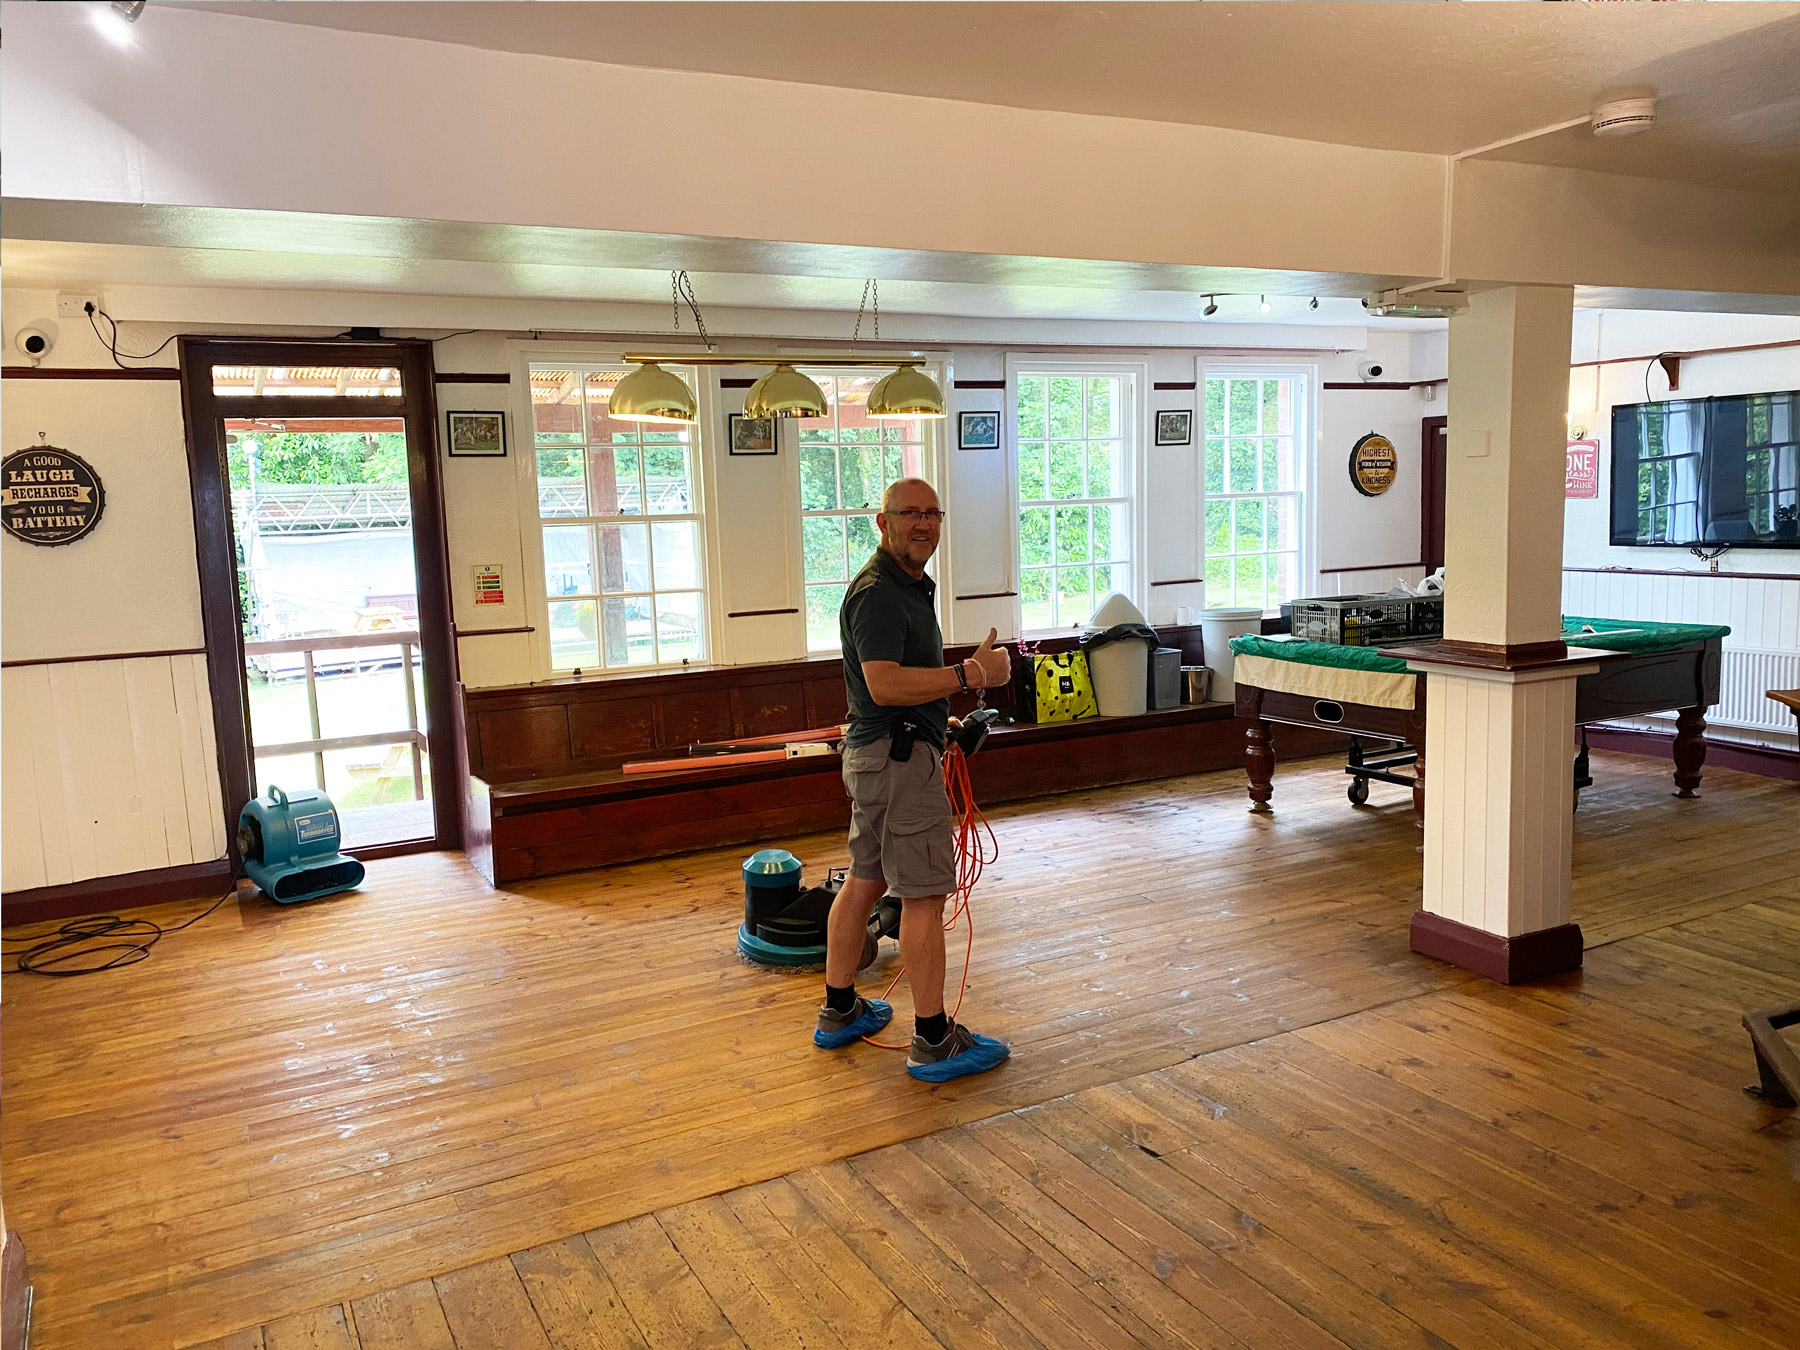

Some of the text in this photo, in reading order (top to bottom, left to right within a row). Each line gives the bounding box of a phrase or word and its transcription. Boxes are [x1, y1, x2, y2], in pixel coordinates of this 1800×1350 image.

[1362, 448, 1391, 458] HIGHEST
[23, 456, 61, 467] A GOOD
[8, 469, 75, 483] LAUGH
[1361, 476, 1391, 485] KINDNESS
[1573, 480, 1593, 489] WINE
[11, 486, 79, 499] RECHARGES
[30, 505, 64, 514] YOUR
[11, 515, 86, 529] BATTERY
